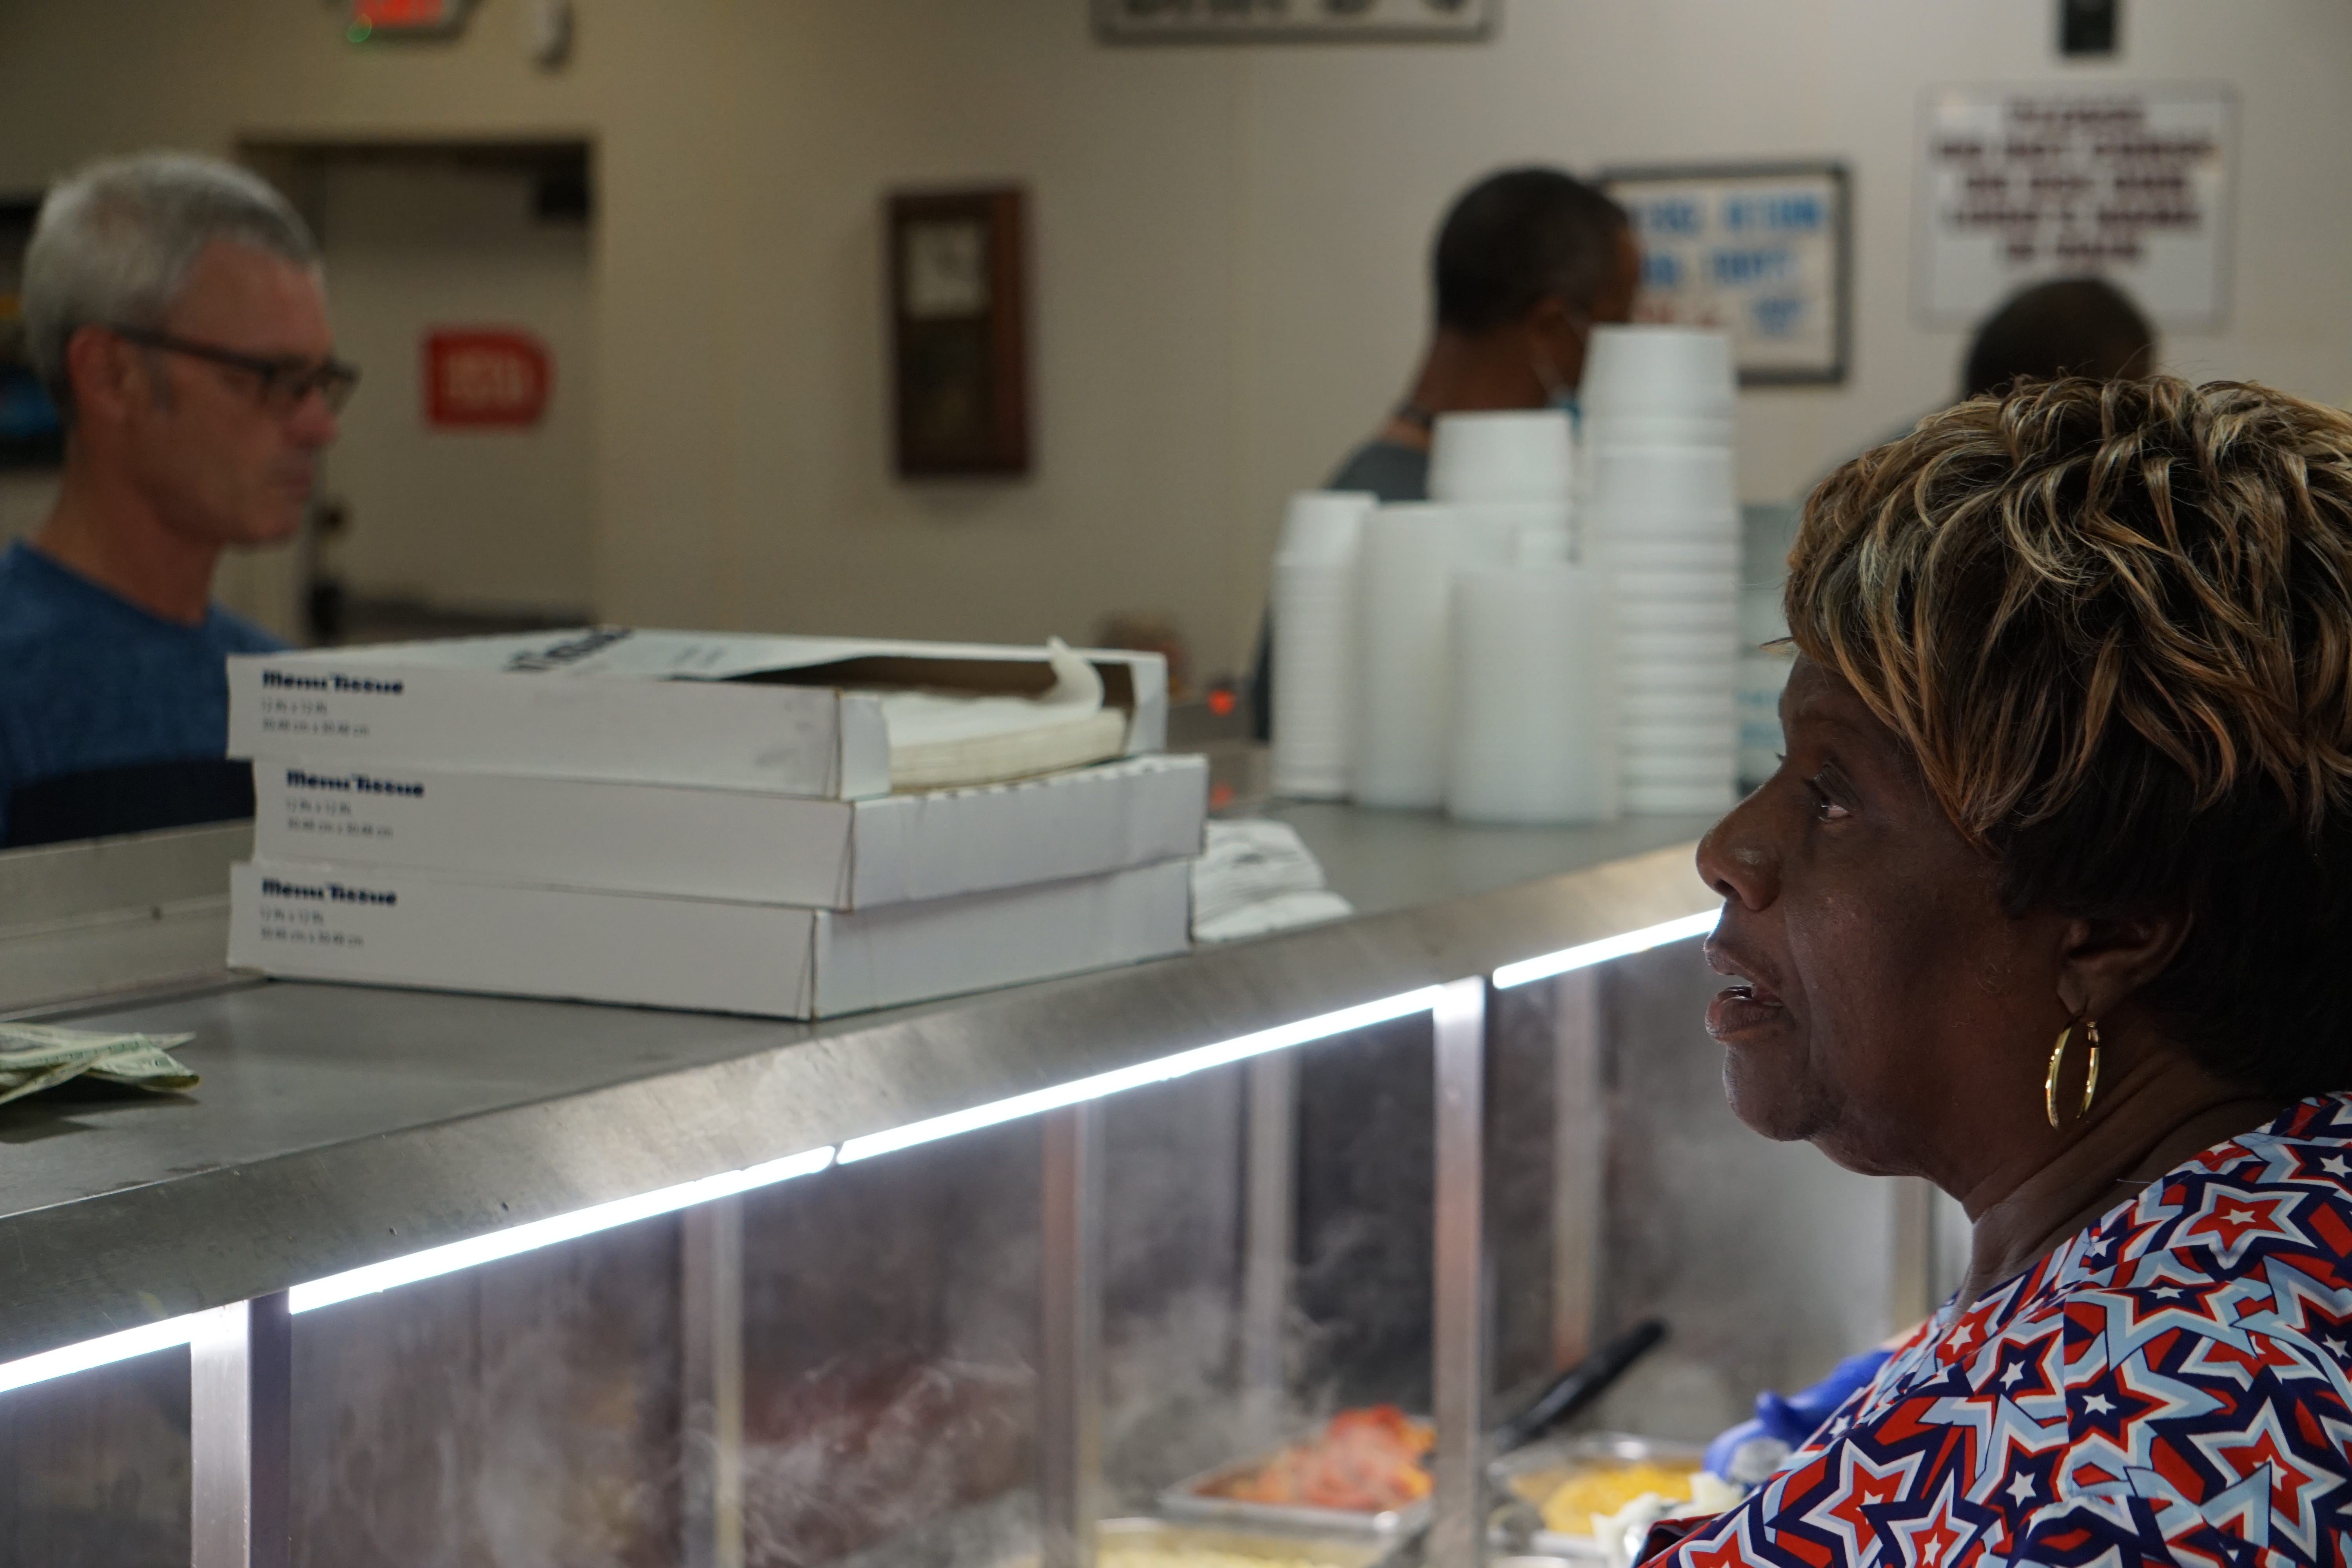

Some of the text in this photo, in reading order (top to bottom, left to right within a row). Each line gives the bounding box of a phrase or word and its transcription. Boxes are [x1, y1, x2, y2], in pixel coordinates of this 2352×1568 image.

[263, 669, 404, 695] Menu Tissue
[287, 768, 425, 798] Menu Tissue
[262, 877, 397, 906] Menu Tissue
